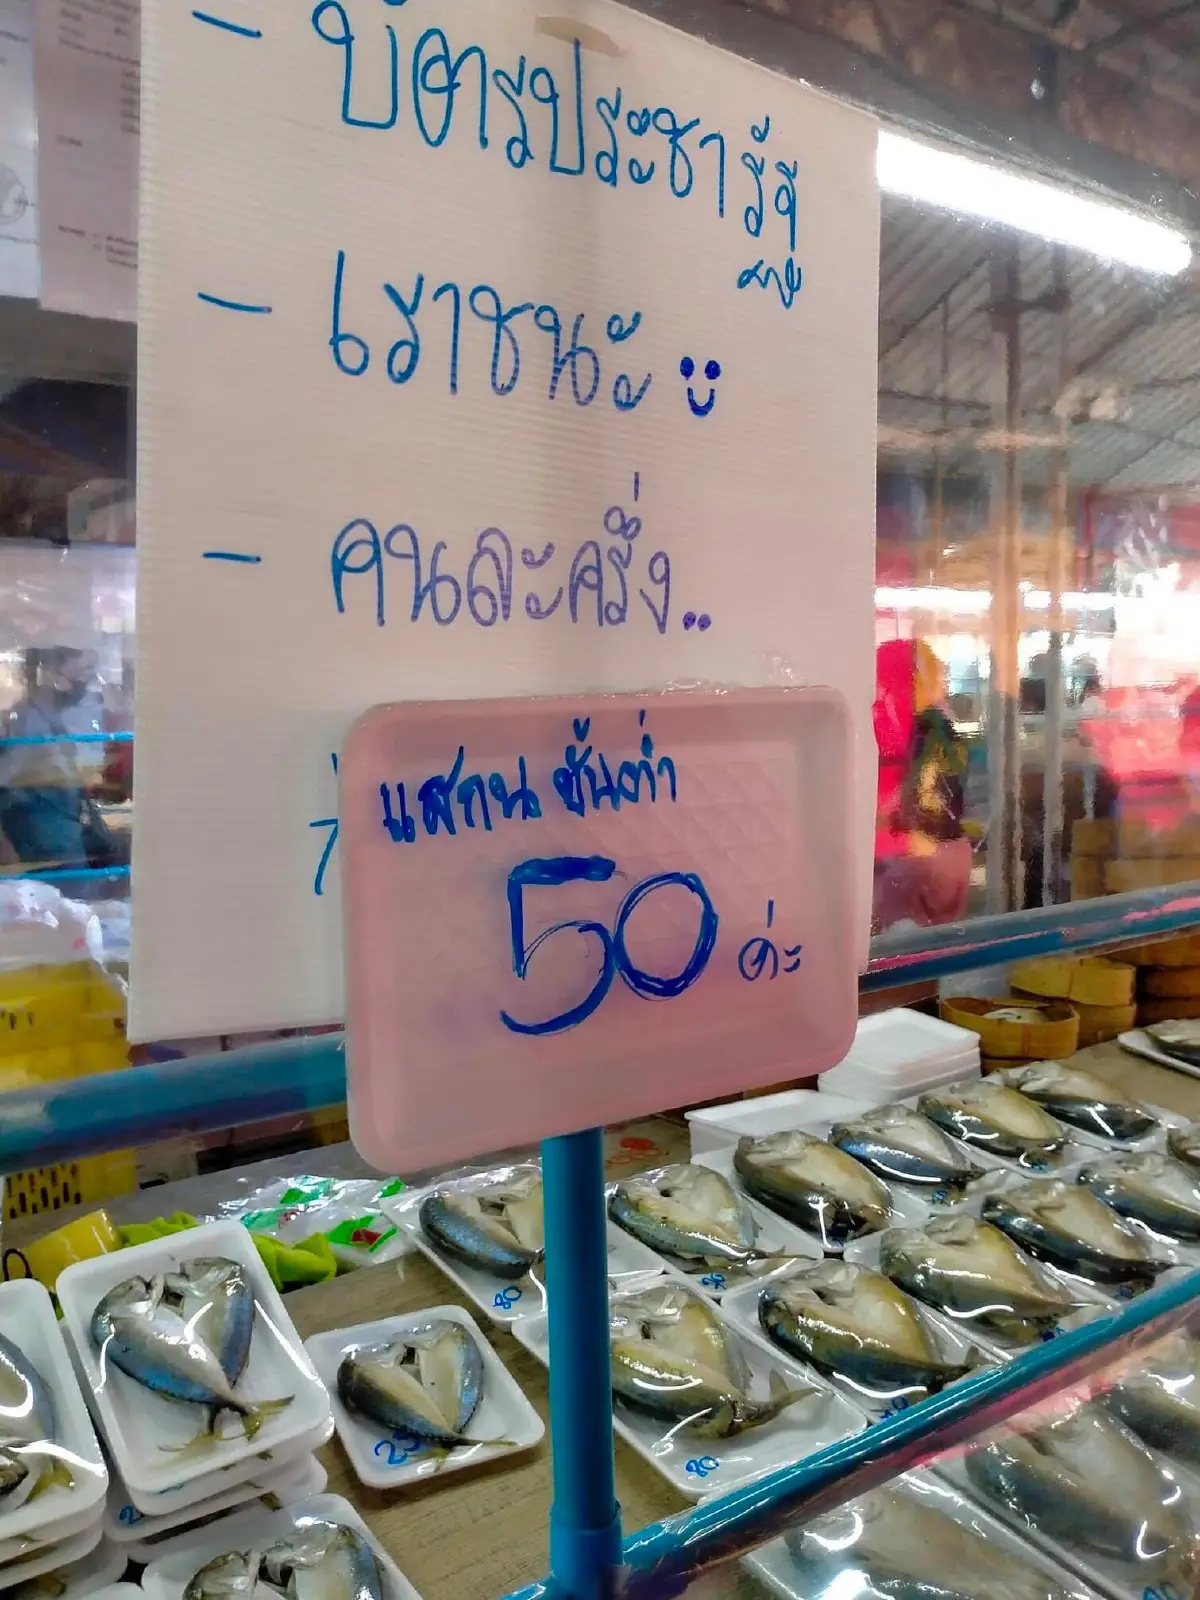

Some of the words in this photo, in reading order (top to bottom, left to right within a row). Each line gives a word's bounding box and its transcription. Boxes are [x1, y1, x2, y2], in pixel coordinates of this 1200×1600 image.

[329, 250, 652, 411] เราชนะ
[500, 854, 719, 1037] 50
